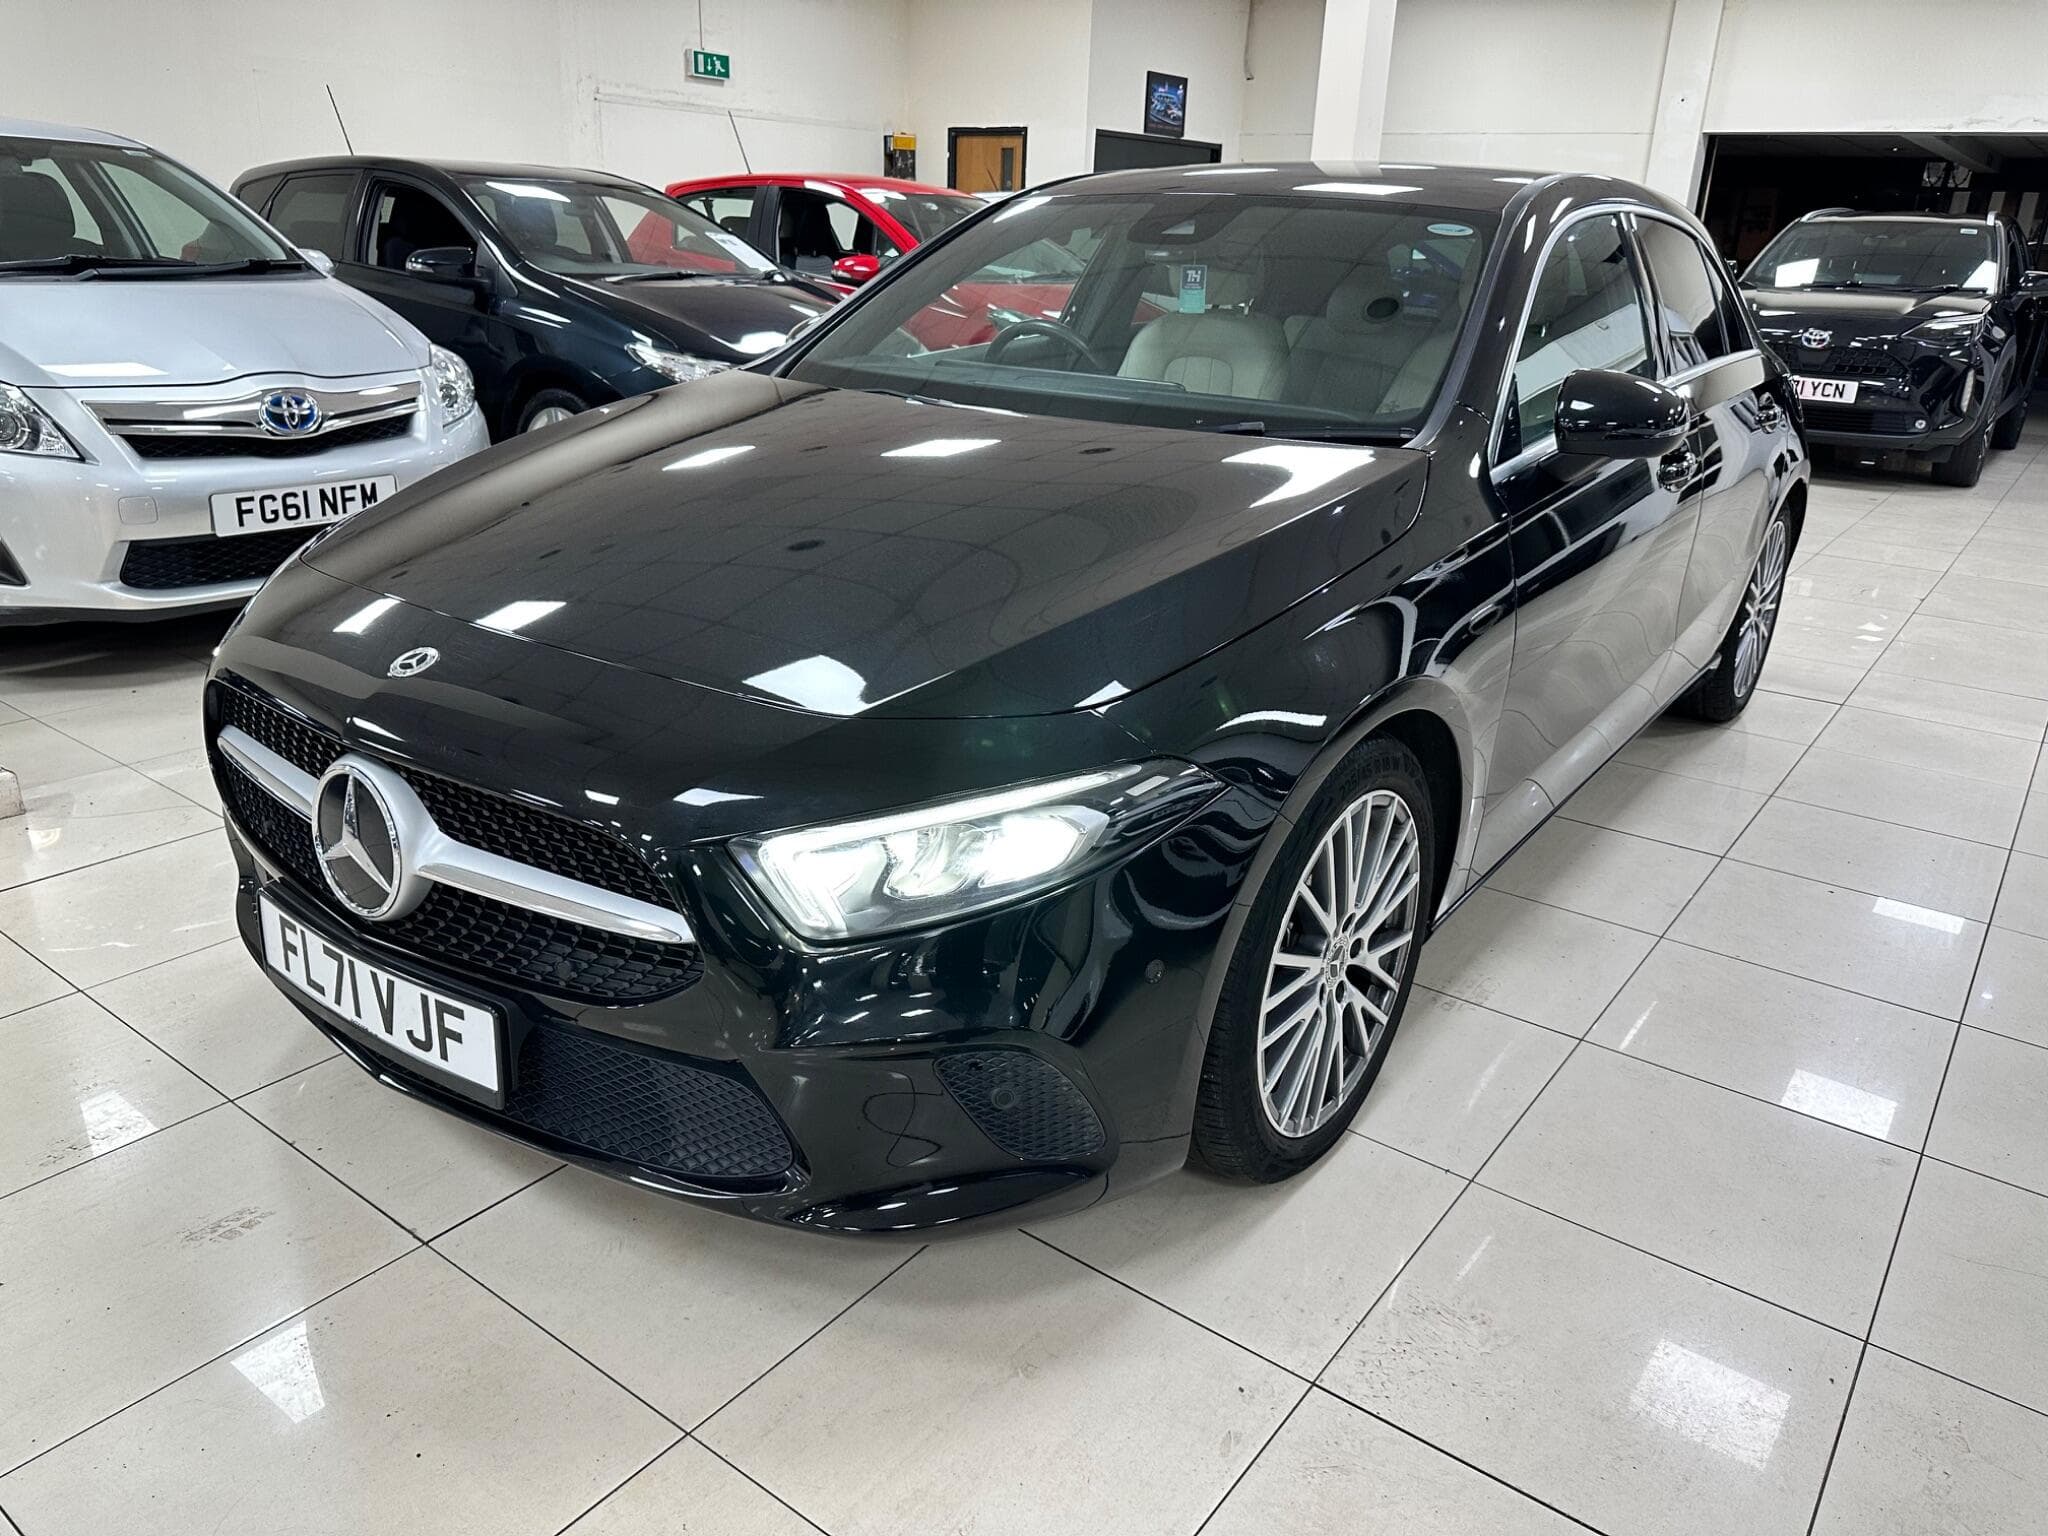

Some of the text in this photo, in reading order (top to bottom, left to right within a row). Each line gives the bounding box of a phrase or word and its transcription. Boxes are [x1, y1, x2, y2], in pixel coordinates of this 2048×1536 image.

[1811, 381, 1846, 398] YCN
[235, 482, 378, 527] FG61 NFM
[279, 914, 362, 1019] FL71
